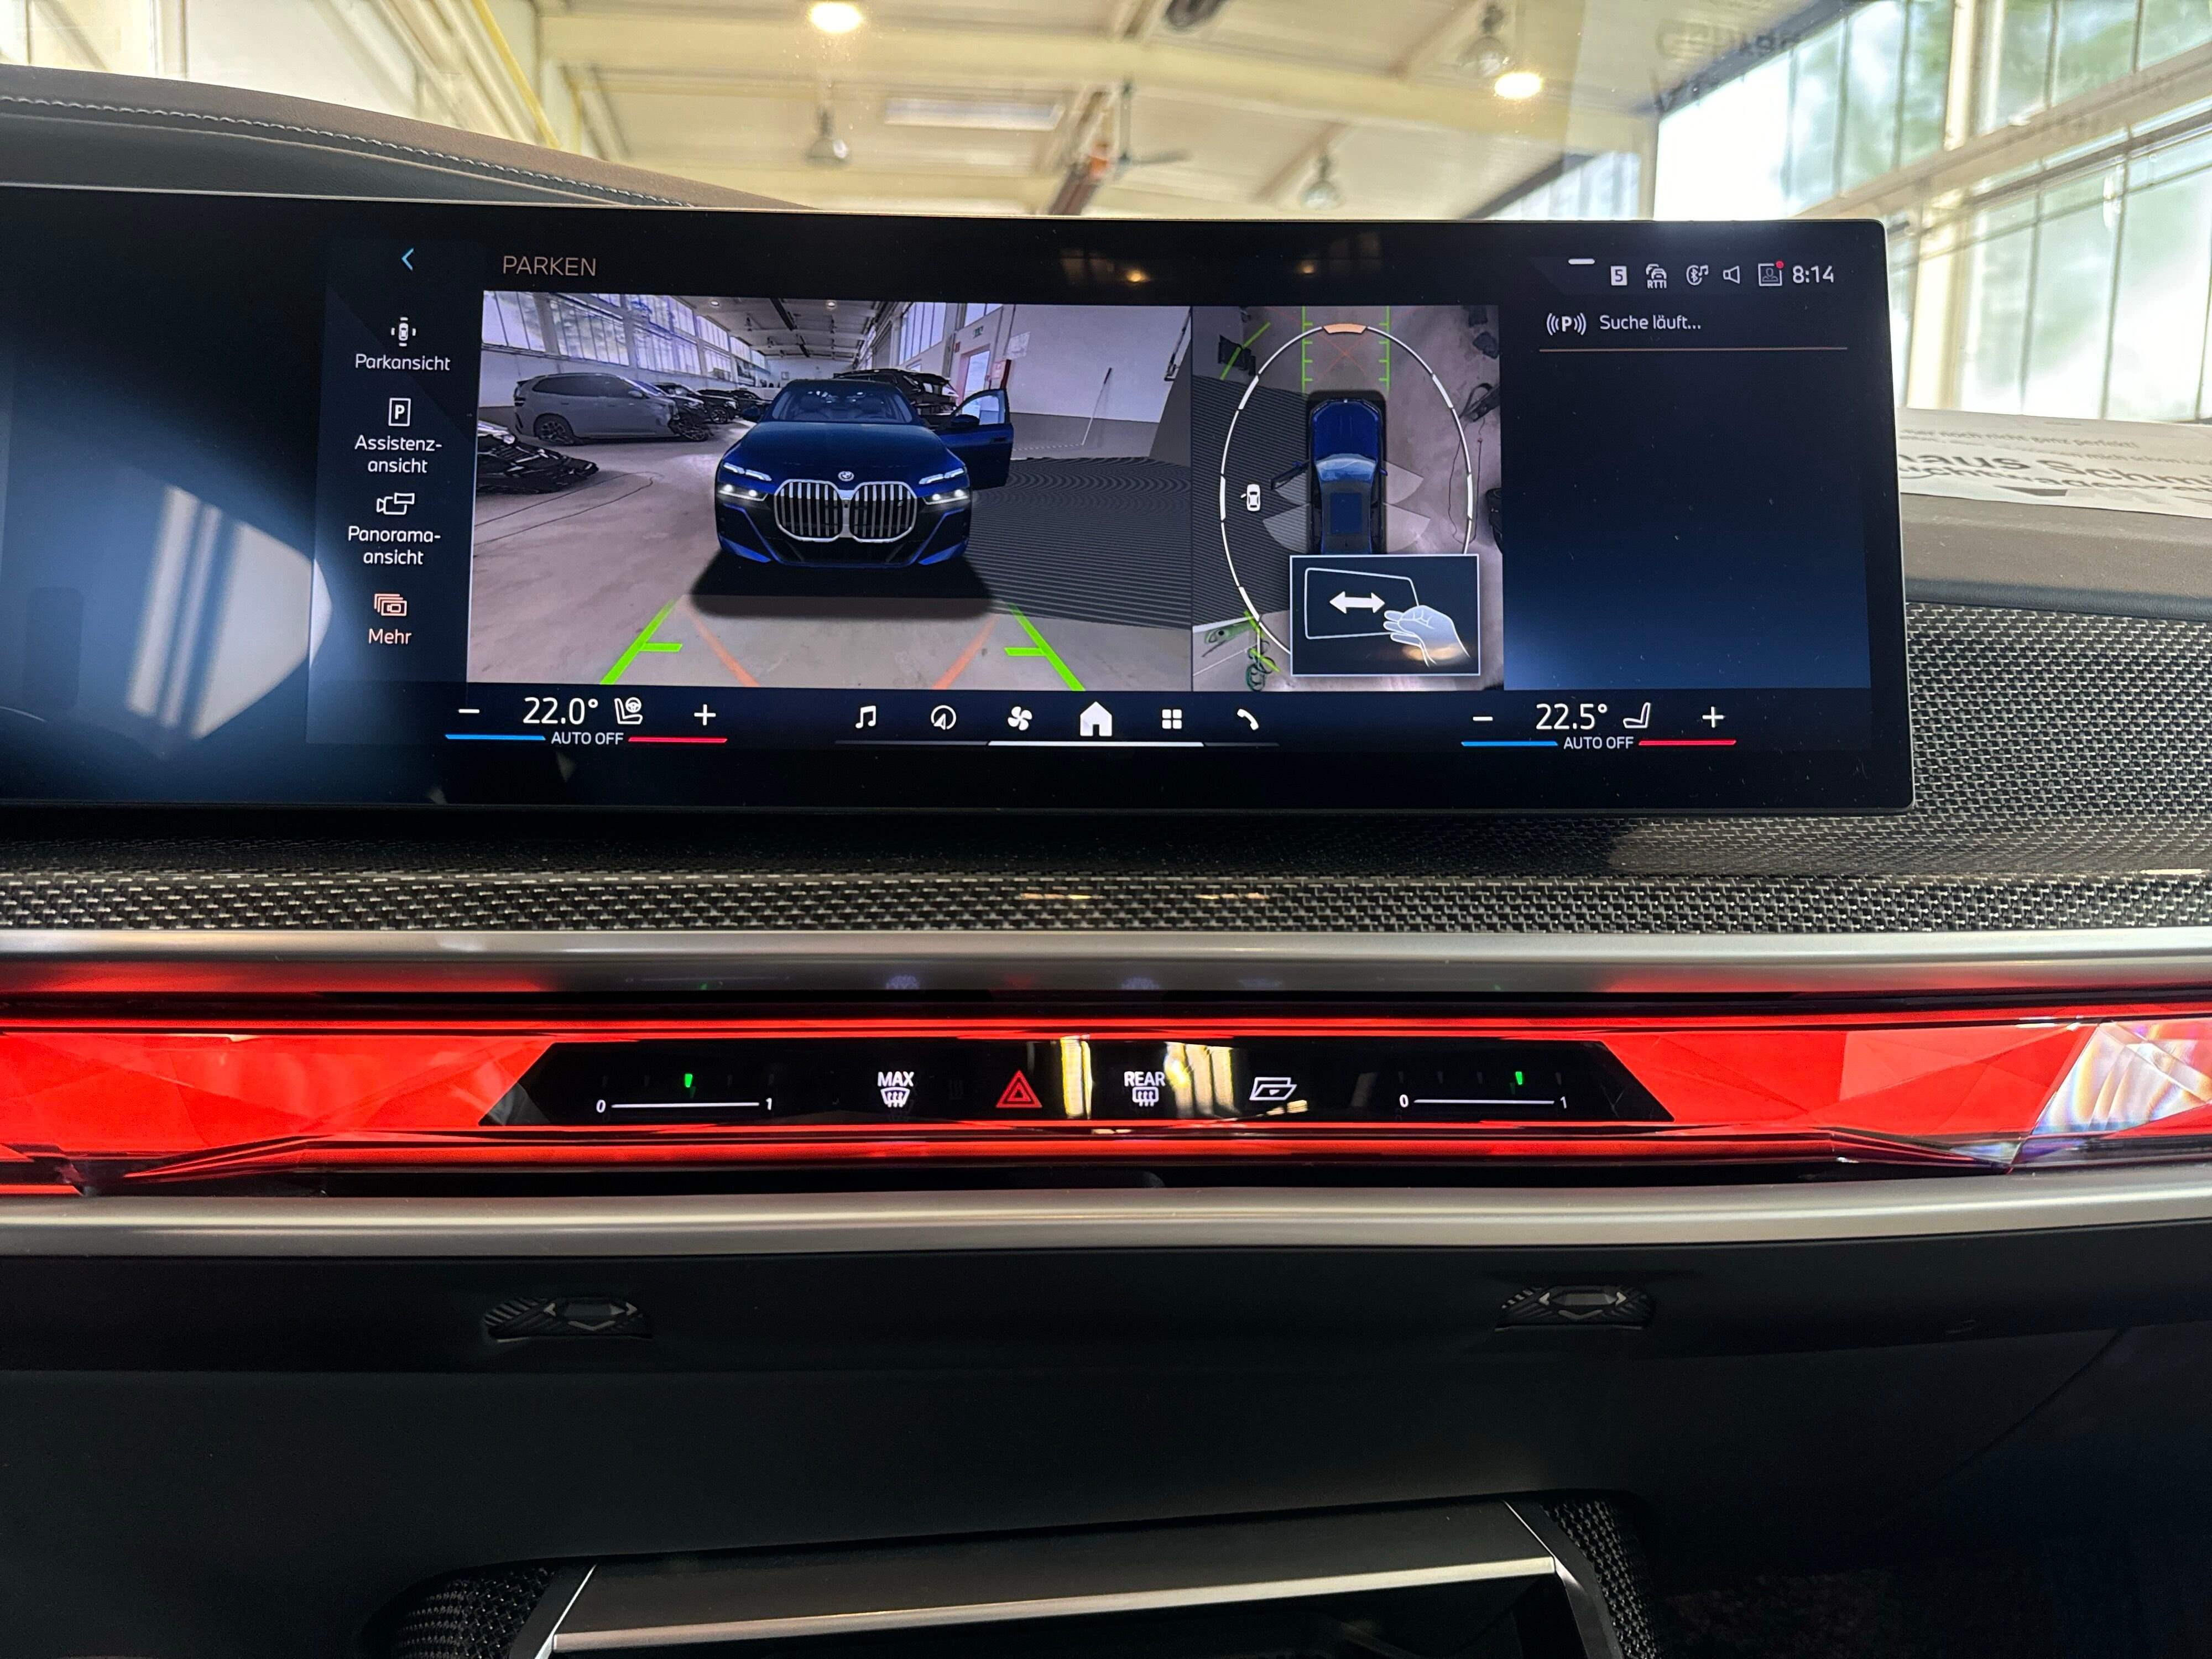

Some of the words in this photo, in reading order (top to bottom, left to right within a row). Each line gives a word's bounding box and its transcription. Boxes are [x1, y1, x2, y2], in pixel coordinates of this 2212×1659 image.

[503, 255, 596, 276] PARKEN
[1614, 269, 1624, 282] 5
[1792, 265, 1834, 284] 8:14
[1647, 279, 1667, 289] RTTI
[1599, 315, 1649, 330] Suche
[1652, 314, 1702, 330] läuft...
[354, 353, 451, 371] Parkansicht
[394, 404, 405, 420] P
[354, 434, 443, 452] Assistenz-
[367, 457, 428, 474] ansicht
[347, 525, 441, 543] Panorama-
[362, 549, 424, 565] ansicht
[368, 628, 413, 645] Mehr
[522, 696, 598, 725] 22.0°
[1535, 702, 1608, 730] 22.5°
[551, 731, 592, 745] AUTO
[595, 732, 624, 745] OFF
[1563, 736, 1603, 749] AUTO
[1606, 736, 1634, 749] OFF
[877, 1070, 915, 1087] MAX
[1123, 1071, 1166, 1087] REAR
[596, 1099, 606, 1113] 0
[765, 1097, 773, 1111] 1
[1399, 1093, 1409, 1108] 0
[1559, 1096, 1567, 1109] 1
